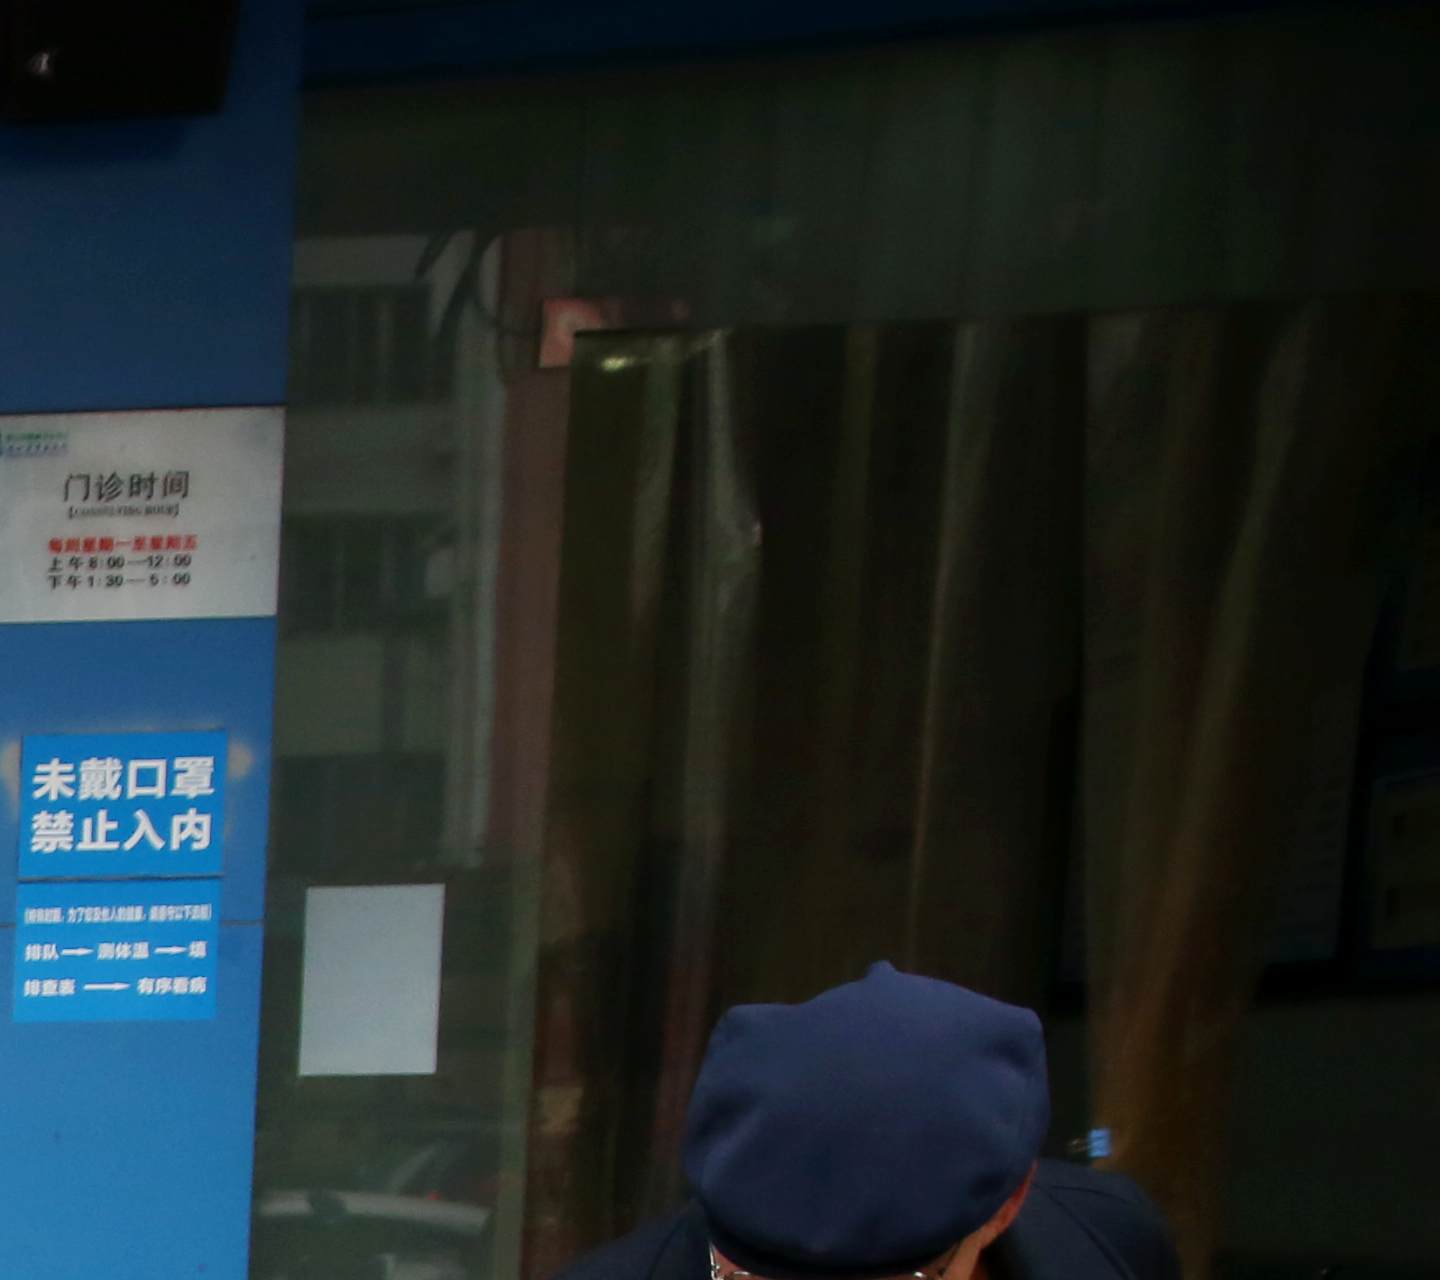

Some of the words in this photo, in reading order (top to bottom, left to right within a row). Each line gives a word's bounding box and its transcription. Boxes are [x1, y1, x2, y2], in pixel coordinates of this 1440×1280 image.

[63, 470, 191, 501] 门诊时间
[32, 756, 215, 800] 未戴口罩
[31, 808, 212, 853] 禁止入内
